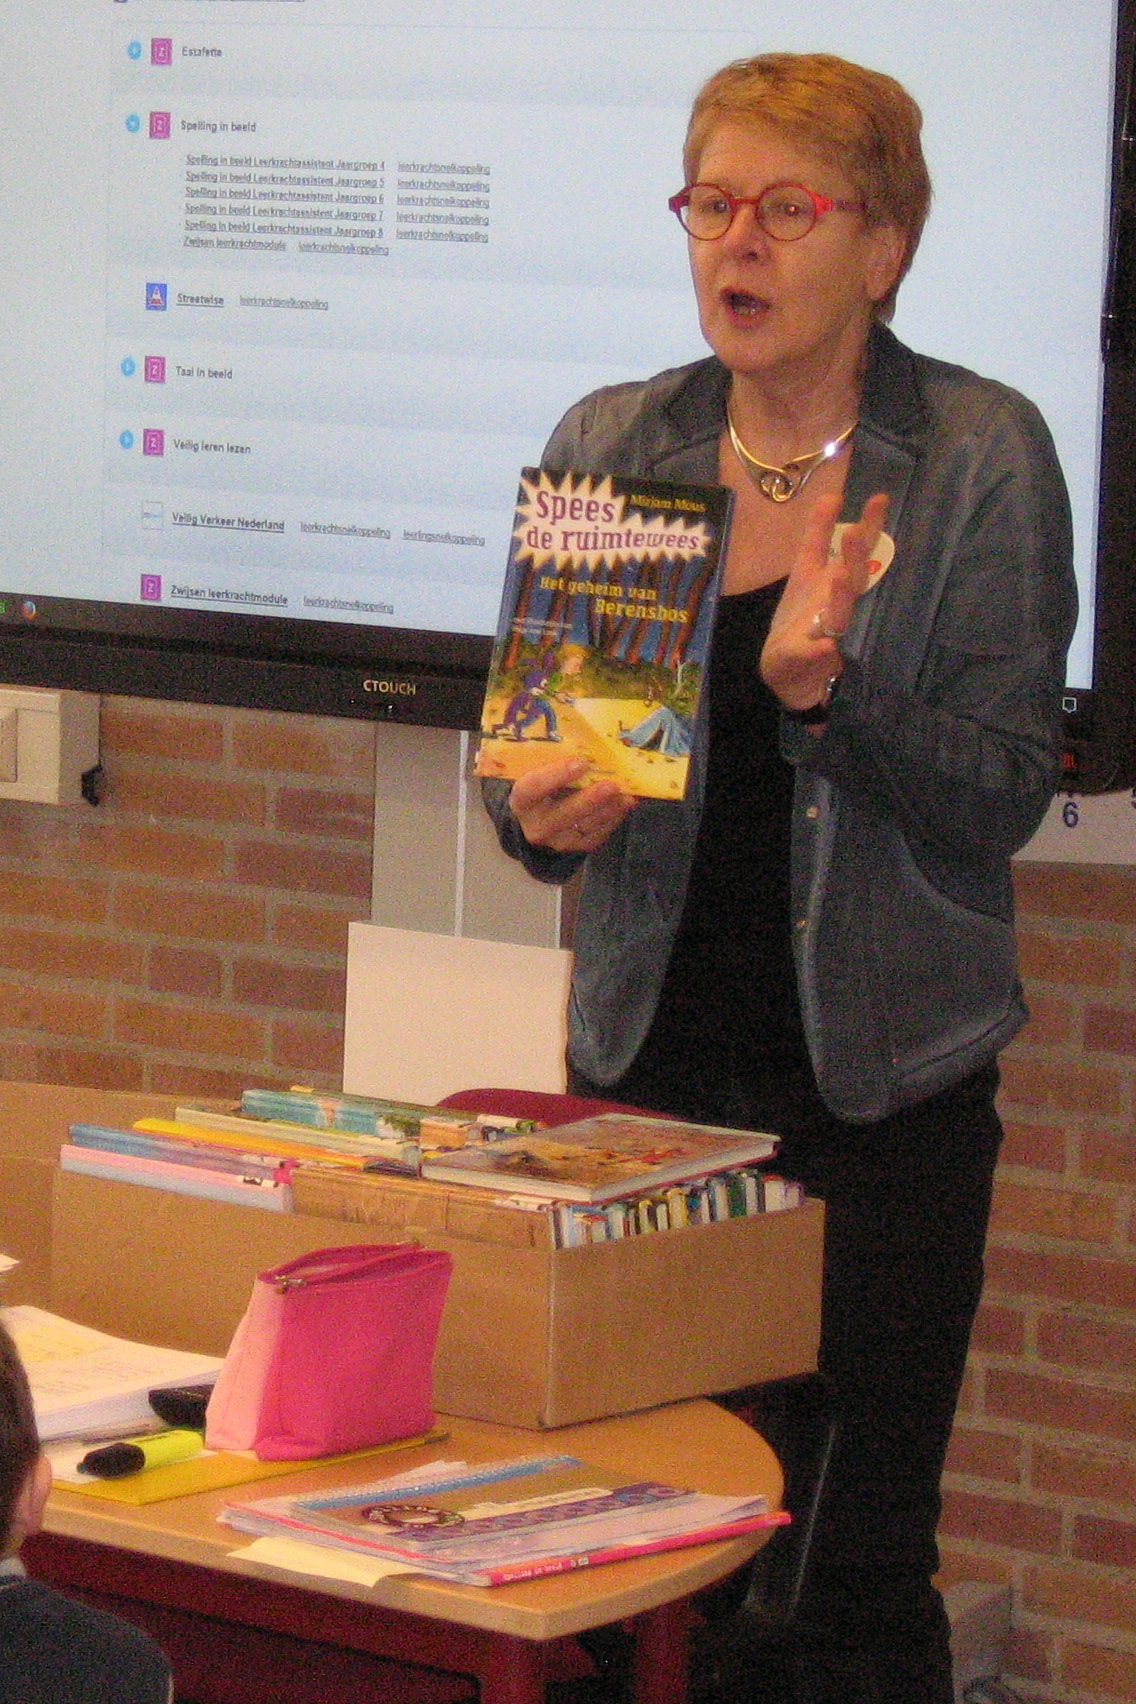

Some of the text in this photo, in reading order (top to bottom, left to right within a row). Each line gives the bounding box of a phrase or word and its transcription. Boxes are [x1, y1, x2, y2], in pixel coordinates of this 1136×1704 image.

[181, 120, 256, 133] Spelling in beeld
[176, 293, 225, 306] Streetwise
[176, 366, 194, 377] Taal
[197, 367, 205, 377] in
[208, 368, 232, 379] beeld
[173, 439, 199, 452] Veilig
[201, 440, 225, 452] leren
[227, 443, 252, 454] lezen
[536, 490, 615, 525] Spees
[172, 512, 198, 526] Veilig
[200, 514, 235, 527] Verkeer
[237, 517, 285, 531] Nederland
[527, 526, 700, 551] de ruimtewees
[171, 585, 205, 598] Zwijsen
[208, 586, 288, 605] leerkrachtmodule
[540, 576, 657, 601] Het geheim van
[594, 598, 689, 623] Berensbos
[363, 679, 416, 696] CTOUCH
[1063, 801, 1078, 828] 6
